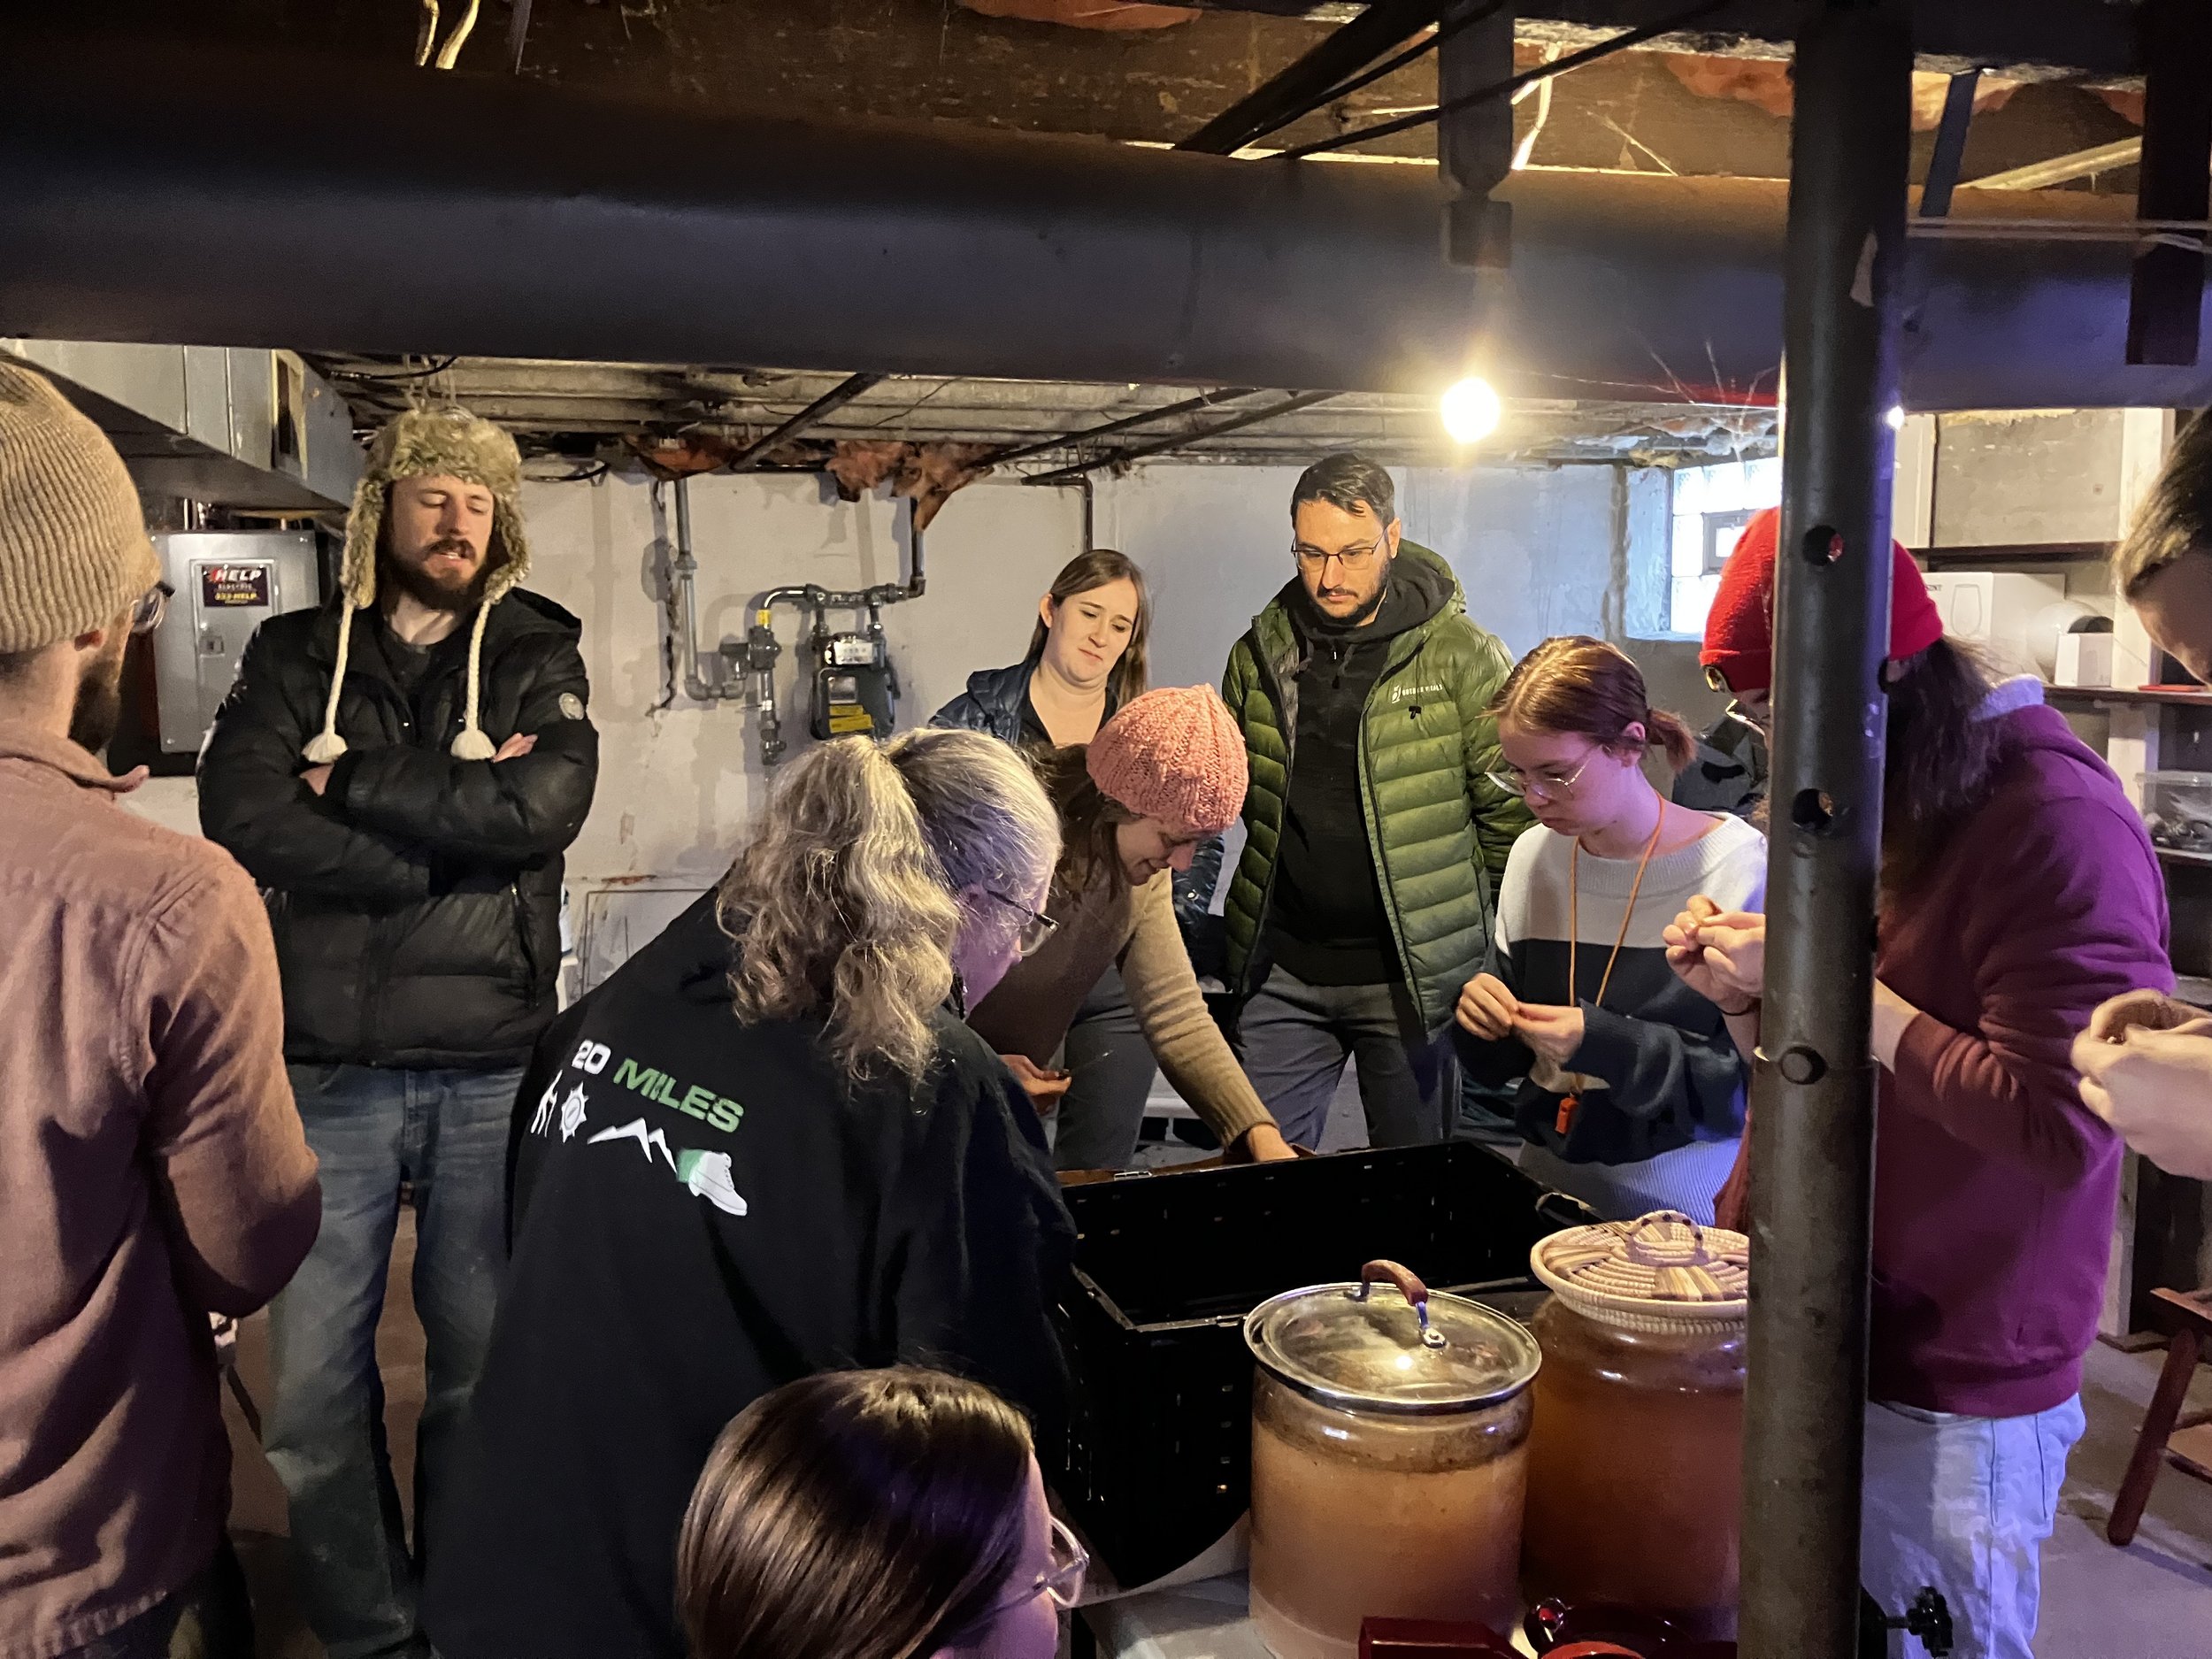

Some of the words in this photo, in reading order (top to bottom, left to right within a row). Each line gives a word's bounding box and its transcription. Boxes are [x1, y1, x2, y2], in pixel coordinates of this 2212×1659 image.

[215, 569, 263, 581] HELP
[572, 1039, 611, 1075] 20
[613, 1057, 744, 1133] MILES
